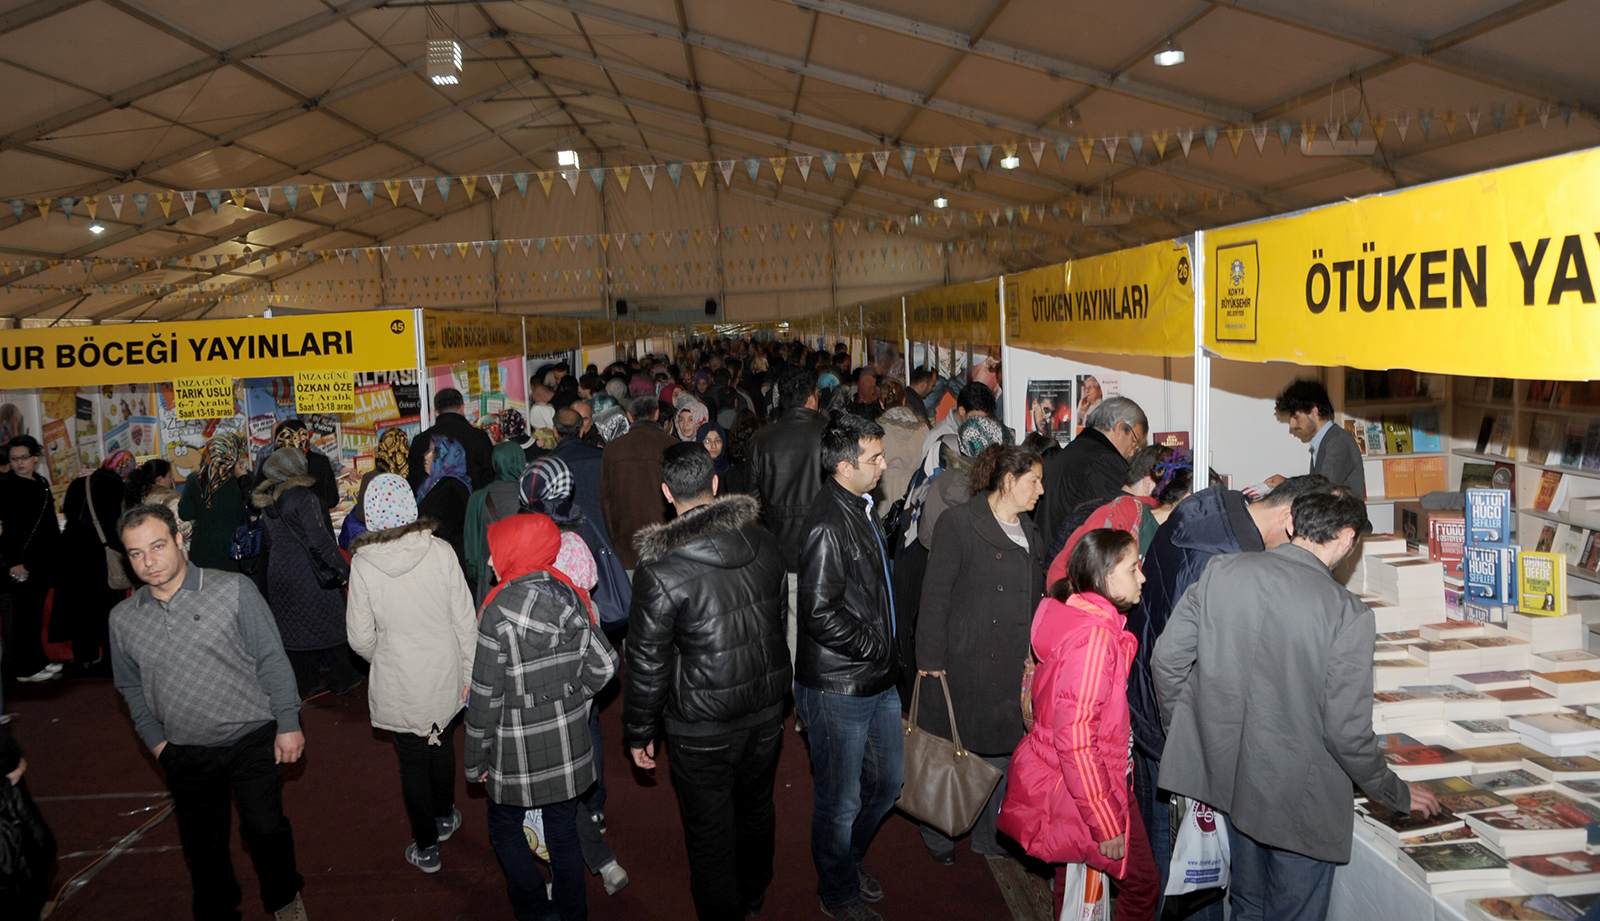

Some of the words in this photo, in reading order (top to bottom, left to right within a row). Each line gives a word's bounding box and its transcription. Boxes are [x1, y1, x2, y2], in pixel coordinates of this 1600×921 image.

[1178, 263, 1189, 280] 26
[1305, 241, 1488, 315] ÖTÜKEN
[1509, 230, 1600, 307] YA
[1228, 287, 1245, 297] KONYA
[1031, 287, 1073, 323] ÖTÜKEN
[1075, 283, 1149, 322] YAYINLARI
[1221, 296, 1251, 310] BÜYÜKŞEHİR
[390, 321, 405, 333] 45
[2, 345, 45, 371] UR
[56, 332, 178, 368] BÖCEĞİ
[189, 330, 353, 362] YAYINLARI
[202, 376, 226, 386] GÜNÜ
[323, 370, 348, 380] GÜNÜ
[176, 387, 206, 399] TARIK
[207, 386, 231, 398] USLU
[296, 382, 331, 393] ÖZKAN
[334, 381, 353, 392] ÖZE
[178, 400, 195, 408] 6-7
[198, 399, 231, 407] Aralık
[298, 394, 315, 402] 6-7
[318, 393, 352, 401] Aralık
[355, 389, 395, 415] LLAH'I
[179, 409, 195, 418] Saat
[196, 408, 216, 418] 13-18
[217, 409, 233, 417] arası
[299, 402, 315, 412] Saat
[316, 402, 335, 411] 13-18
[336, 403, 353, 411] arası
[1468, 491, 1506, 507] VICTOR
[1472, 505, 1502, 519] HUGO
[1436, 523, 1466, 536] FYODO
[1436, 535, 1466, 543] DOSTOYEVS
[1464, 546, 1499, 564] VICTOR
[1468, 560, 1495, 576] HUGO
[1523, 555, 1553, 570] DANIEL
[1525, 567, 1551, 581] DEFOE
